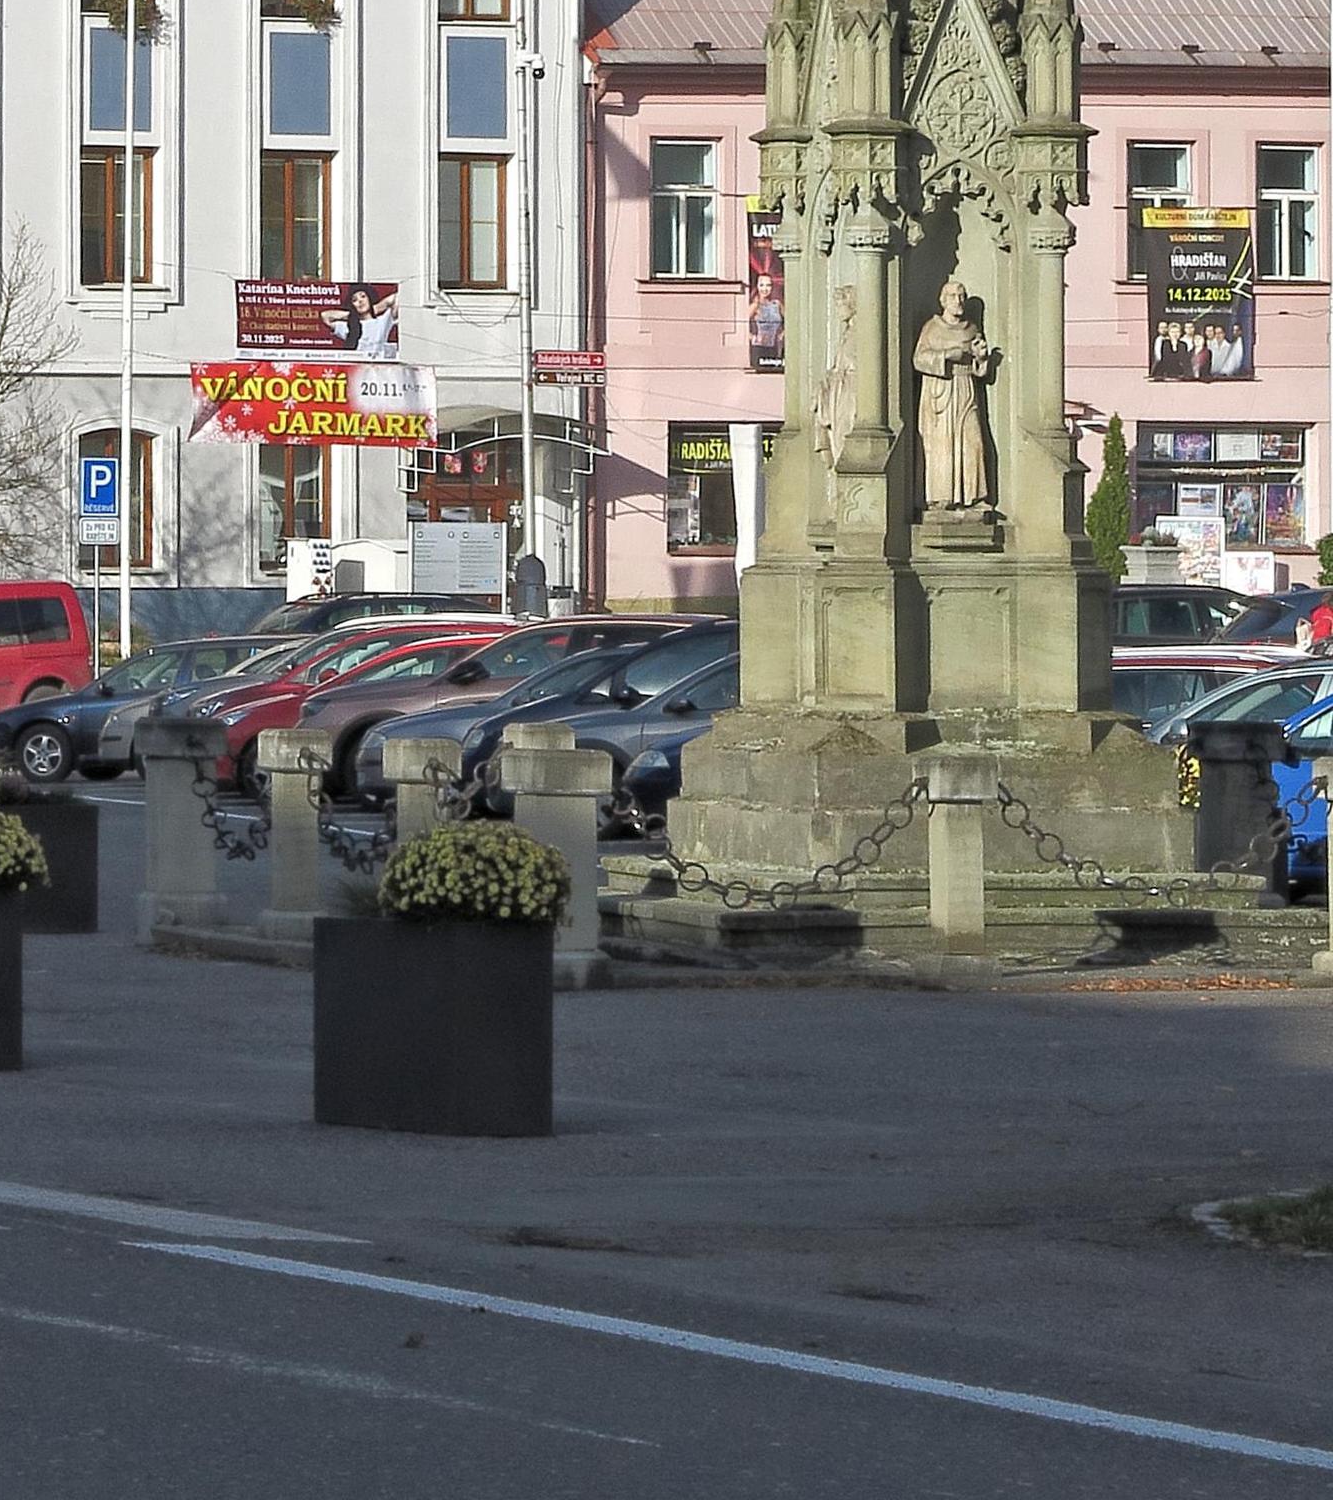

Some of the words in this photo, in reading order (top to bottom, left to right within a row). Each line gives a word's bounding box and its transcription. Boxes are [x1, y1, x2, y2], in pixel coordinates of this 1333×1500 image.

[238, 283, 283, 294] Katarína
[286, 284, 340, 295] Knechtová
[1167, 287, 1232, 301] 14.12.2025
[201, 371, 348, 403] VÁNOČNÍ
[268, 411, 430, 438] JARMARK
[673, 439, 730, 460] HRADIŠŤA
[90, 465, 112, 498] P
